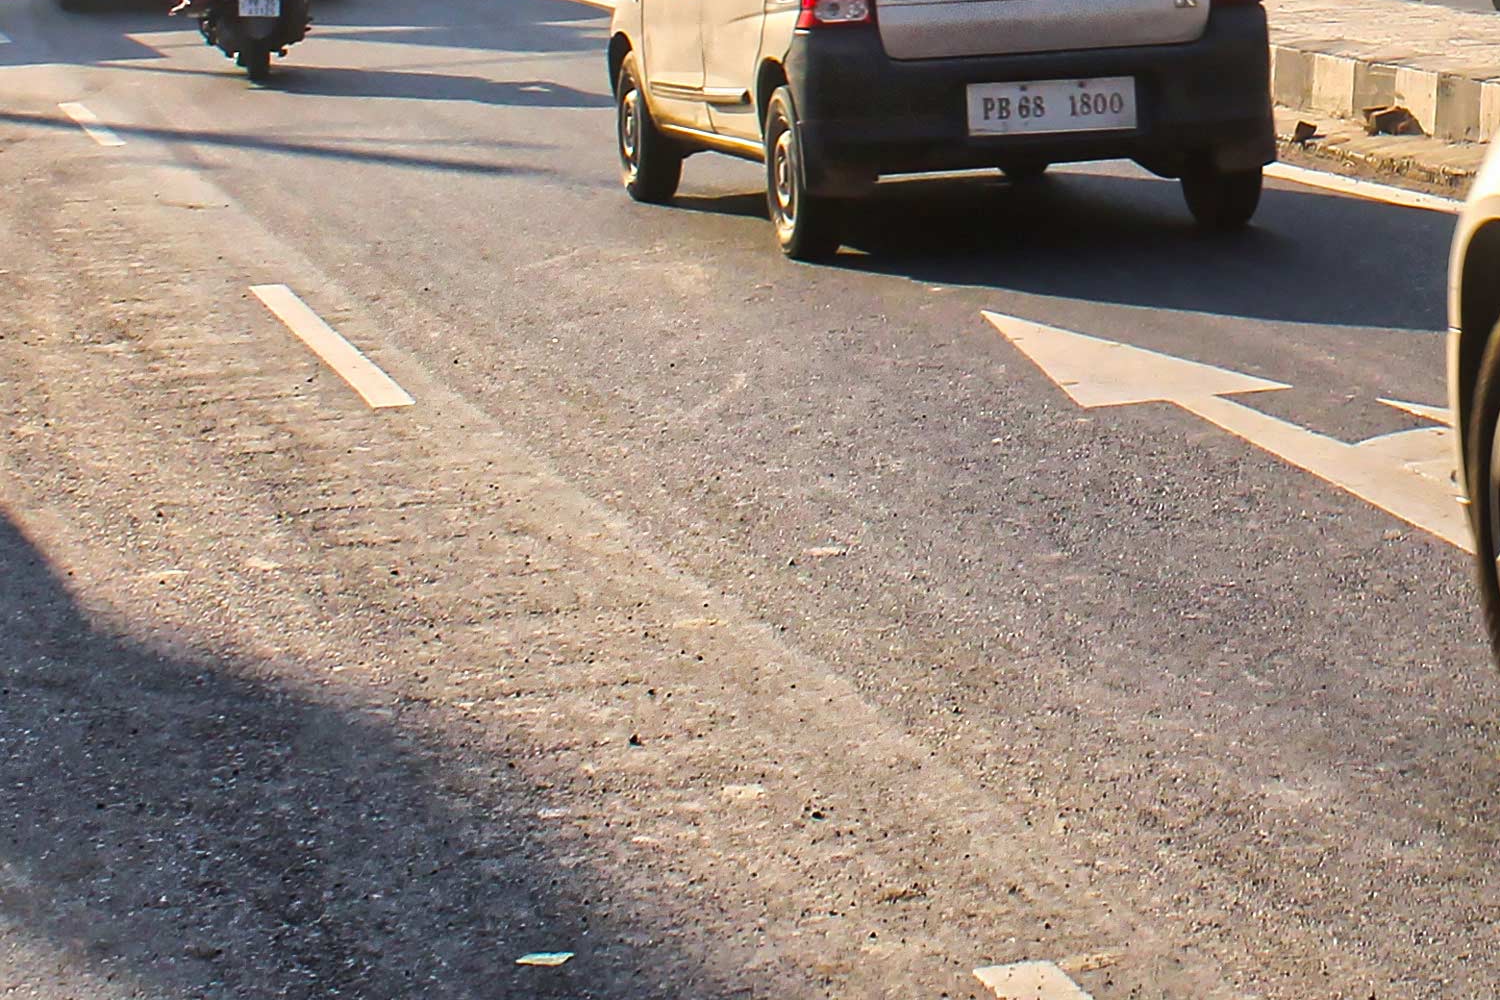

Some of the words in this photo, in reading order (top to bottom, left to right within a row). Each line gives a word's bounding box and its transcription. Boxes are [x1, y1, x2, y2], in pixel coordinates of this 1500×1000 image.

[983, 97, 1011, 120] PB
[1018, 96, 1045, 118] 68
[1069, 92, 1124, 117] 1800
